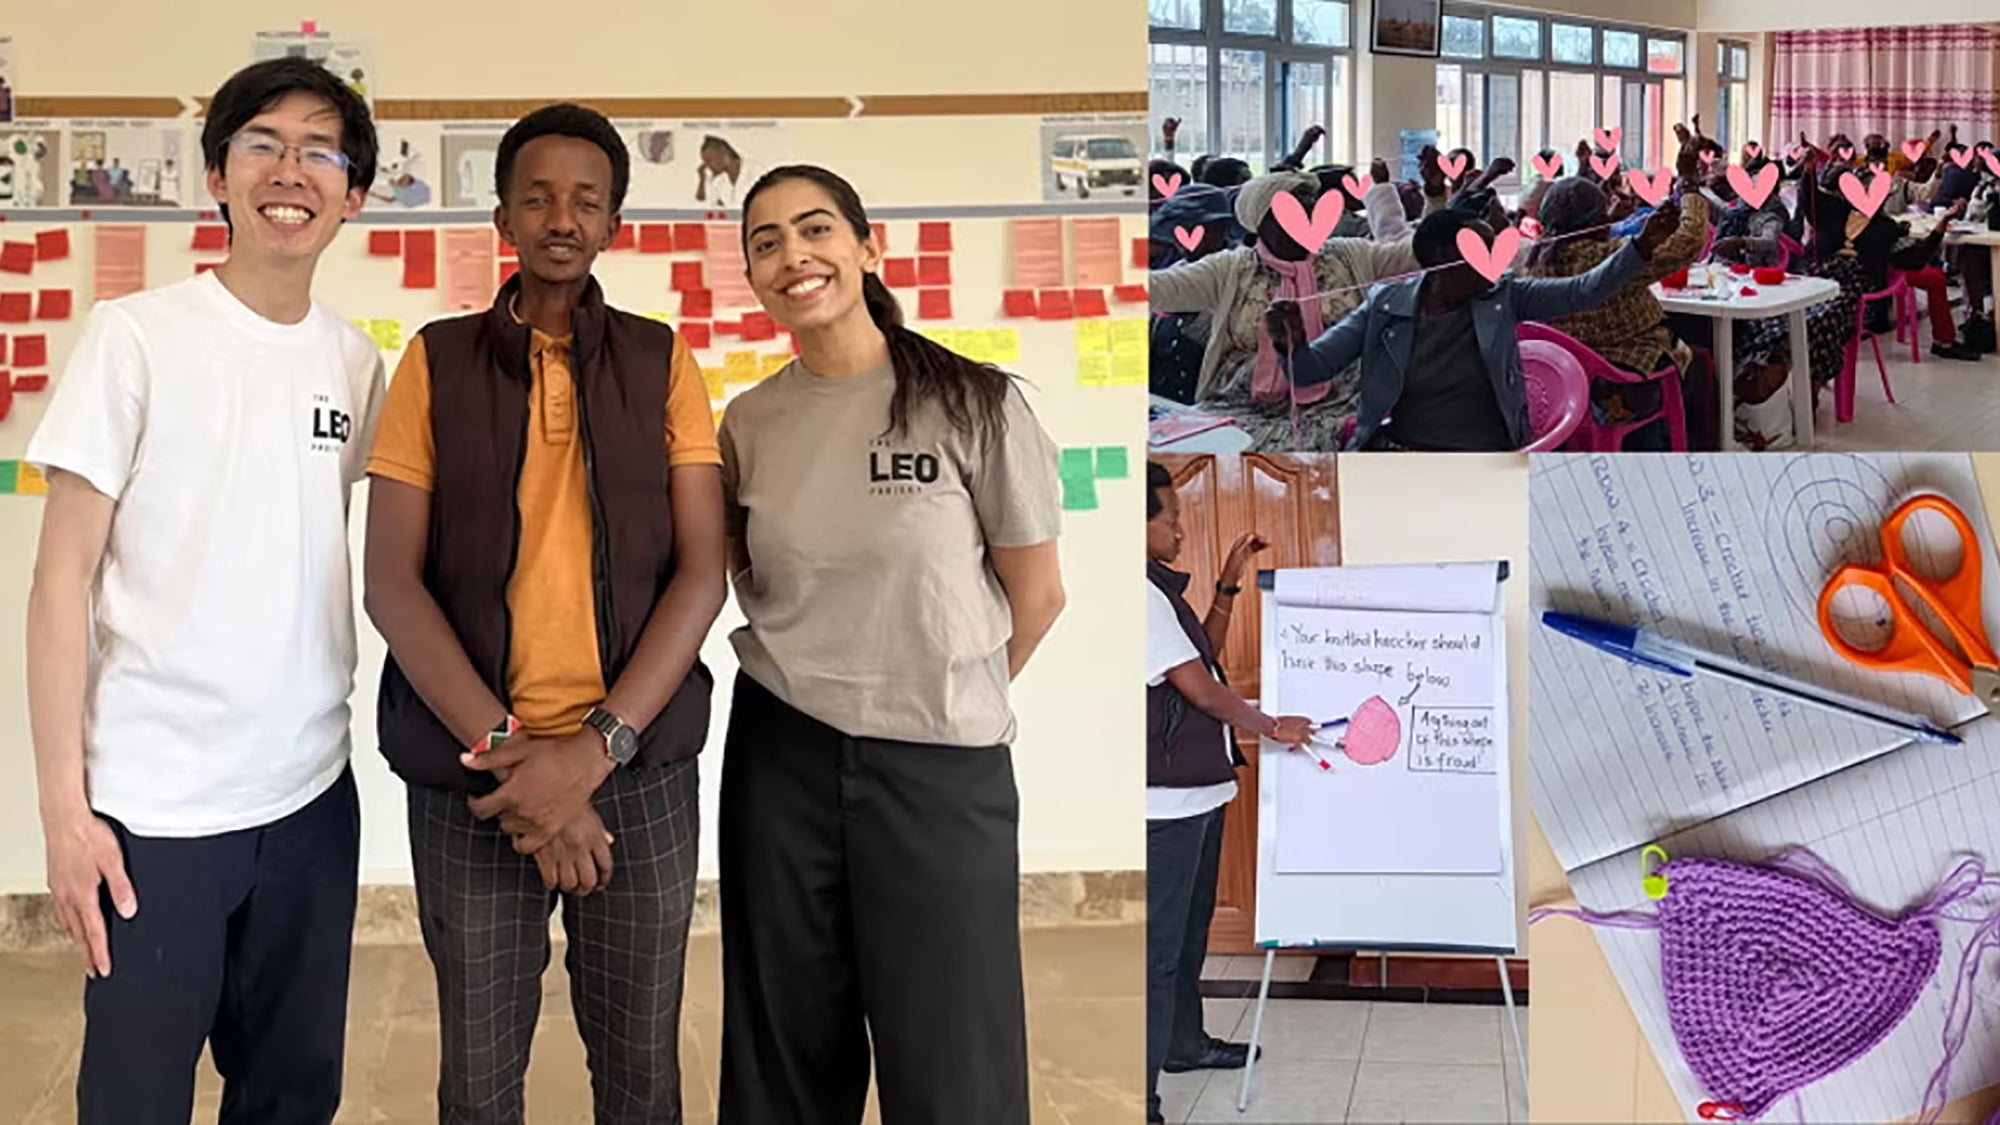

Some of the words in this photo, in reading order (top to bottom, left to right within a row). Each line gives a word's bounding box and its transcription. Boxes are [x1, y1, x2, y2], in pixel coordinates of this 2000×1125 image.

[313, 407, 351, 443] LEO
[870, 451, 939, 484] LEO
[1432, 632, 1481, 651] should
[1324, 656, 1348, 673] this
